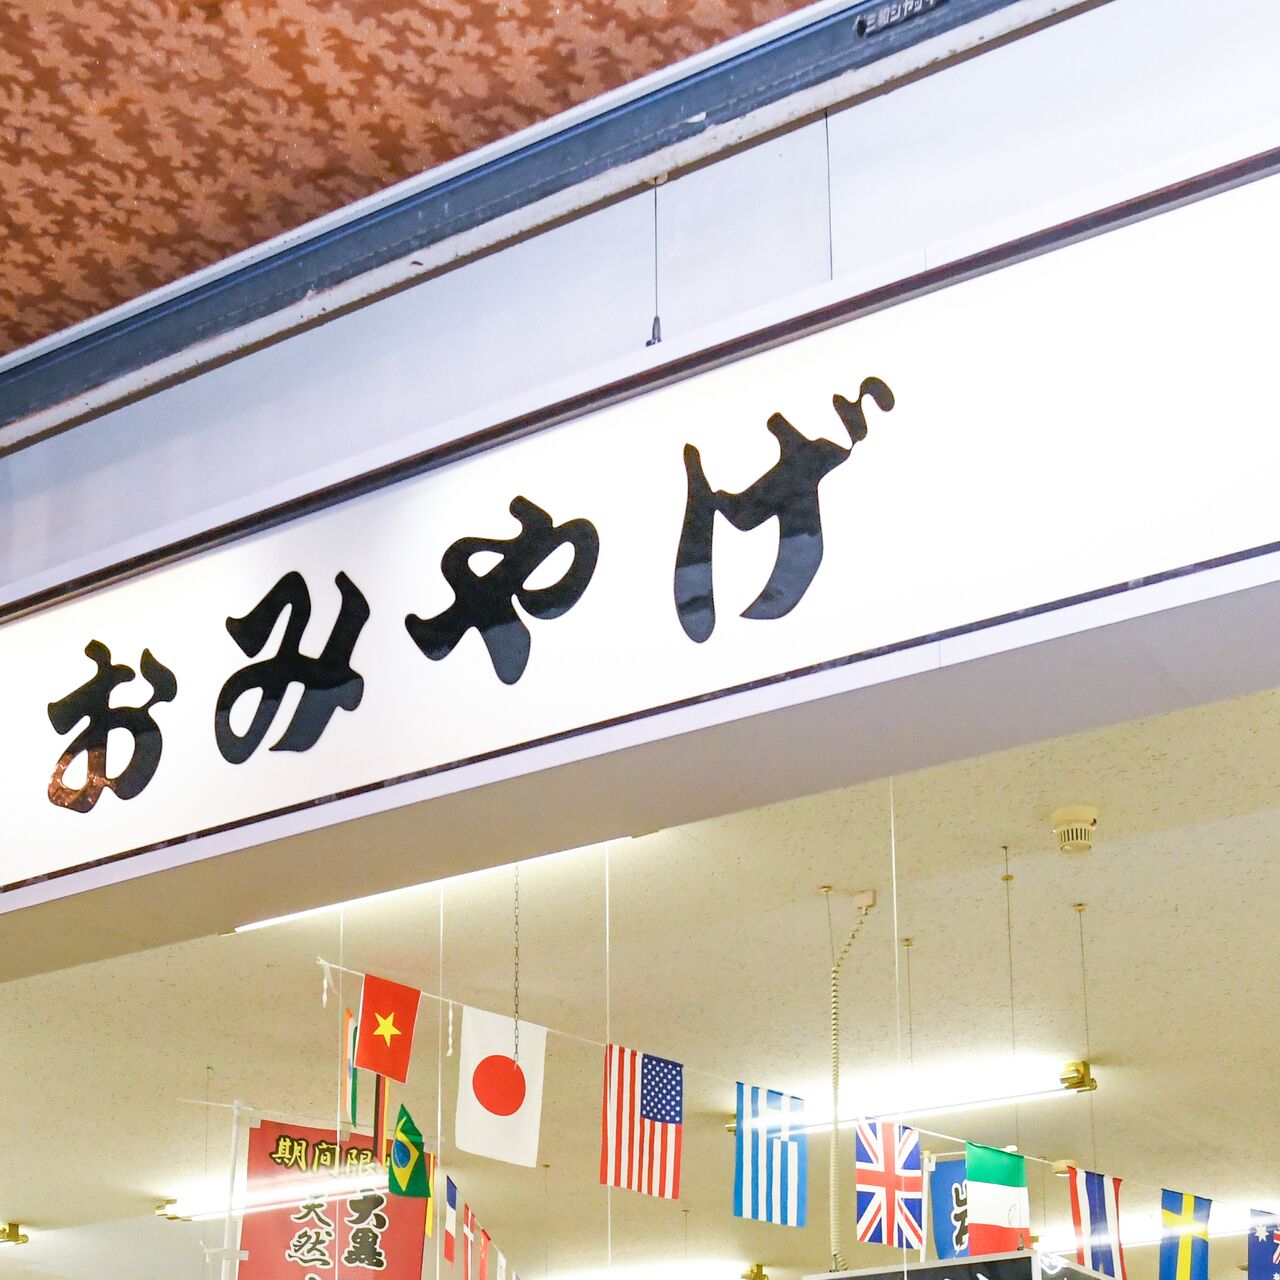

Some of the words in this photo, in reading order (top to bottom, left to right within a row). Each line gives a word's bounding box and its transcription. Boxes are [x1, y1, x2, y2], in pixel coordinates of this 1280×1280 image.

[46, 376, 896, 815] おみやげ
[270, 1135, 388, 1177] 期間限
